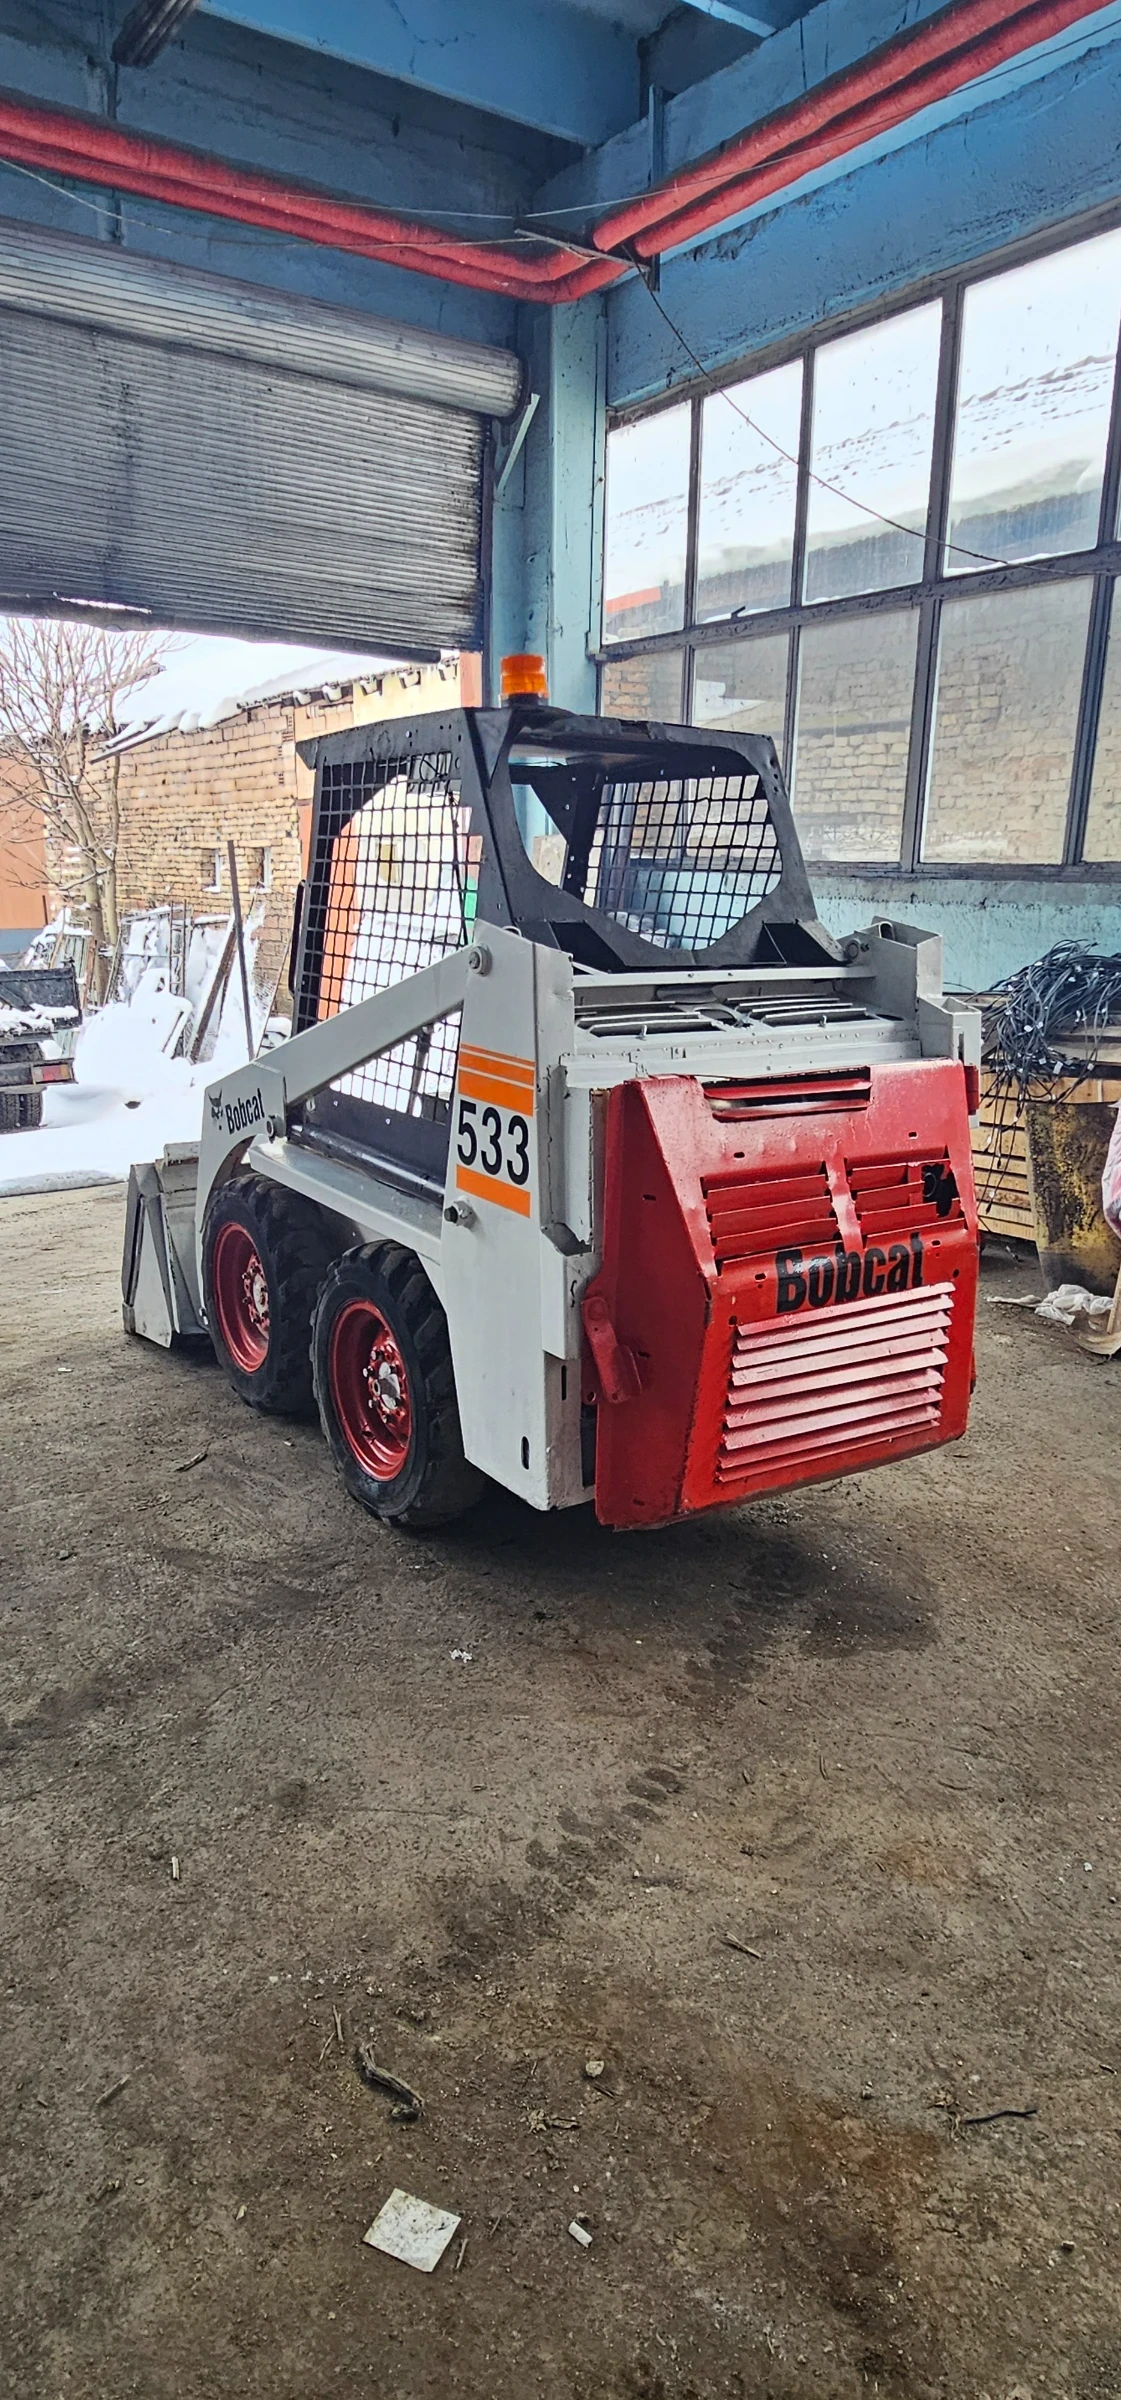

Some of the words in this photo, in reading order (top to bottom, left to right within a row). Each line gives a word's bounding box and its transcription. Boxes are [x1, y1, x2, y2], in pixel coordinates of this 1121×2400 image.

[225, 1087, 265, 1135] Bobcat
[457, 1100, 530, 1186] 533
[775, 1232, 925, 1314] Bobcat
